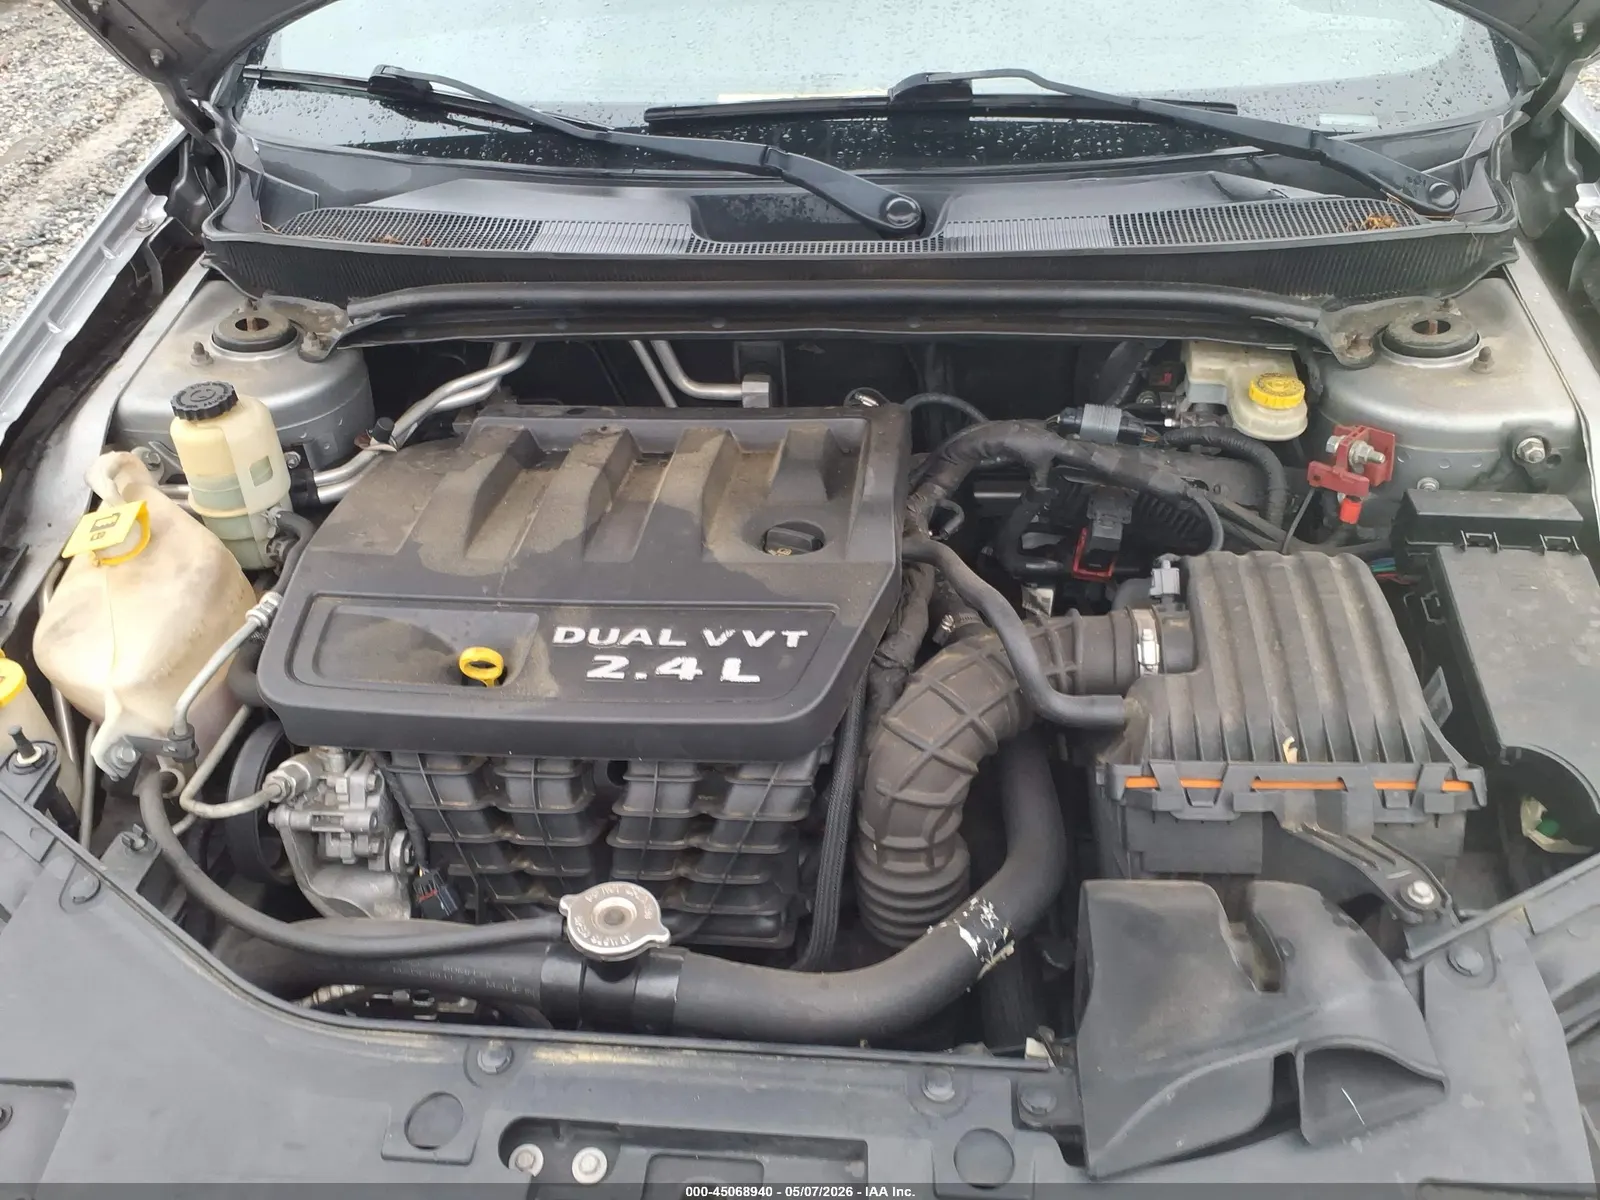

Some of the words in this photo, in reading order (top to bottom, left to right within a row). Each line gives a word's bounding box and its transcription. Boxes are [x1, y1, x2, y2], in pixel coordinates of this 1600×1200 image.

[552, 626, 687, 648] DUAL
[702, 626, 809, 648] VVT
[586, 654, 704, 682] 2.4
[720, 657, 761, 683] L
